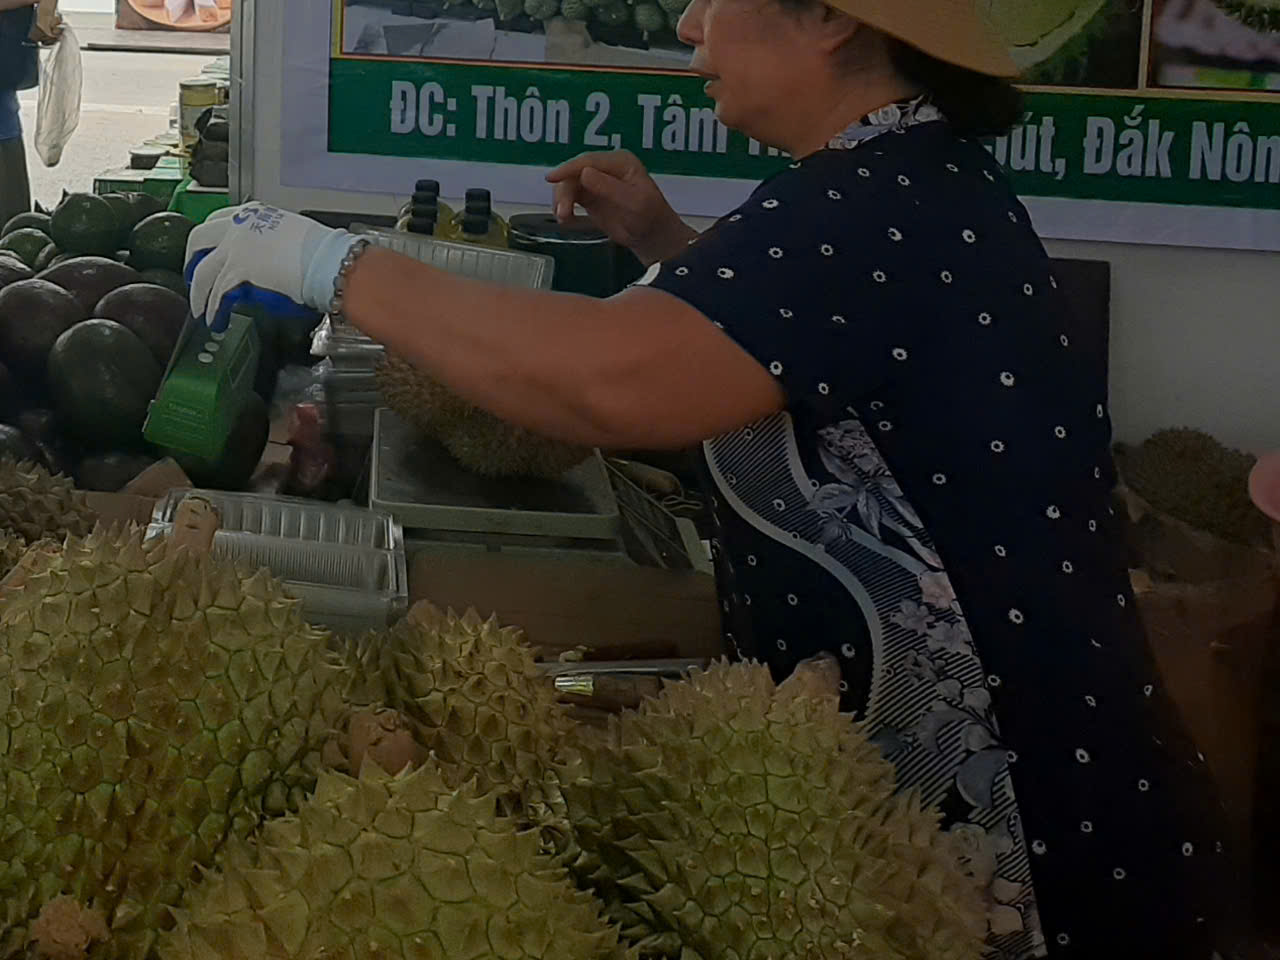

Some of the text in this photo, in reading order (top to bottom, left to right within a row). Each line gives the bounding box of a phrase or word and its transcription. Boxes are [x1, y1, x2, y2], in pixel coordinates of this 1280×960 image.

[389, 80, 457, 137] ĐC:
[471, 85, 570, 145] Thôn
[583, 91, 621, 150] 2,
[637, 94, 728, 154] Tâm
[1083, 105, 1175, 178] Đắk
[1188, 121, 1280, 183] Nôn
